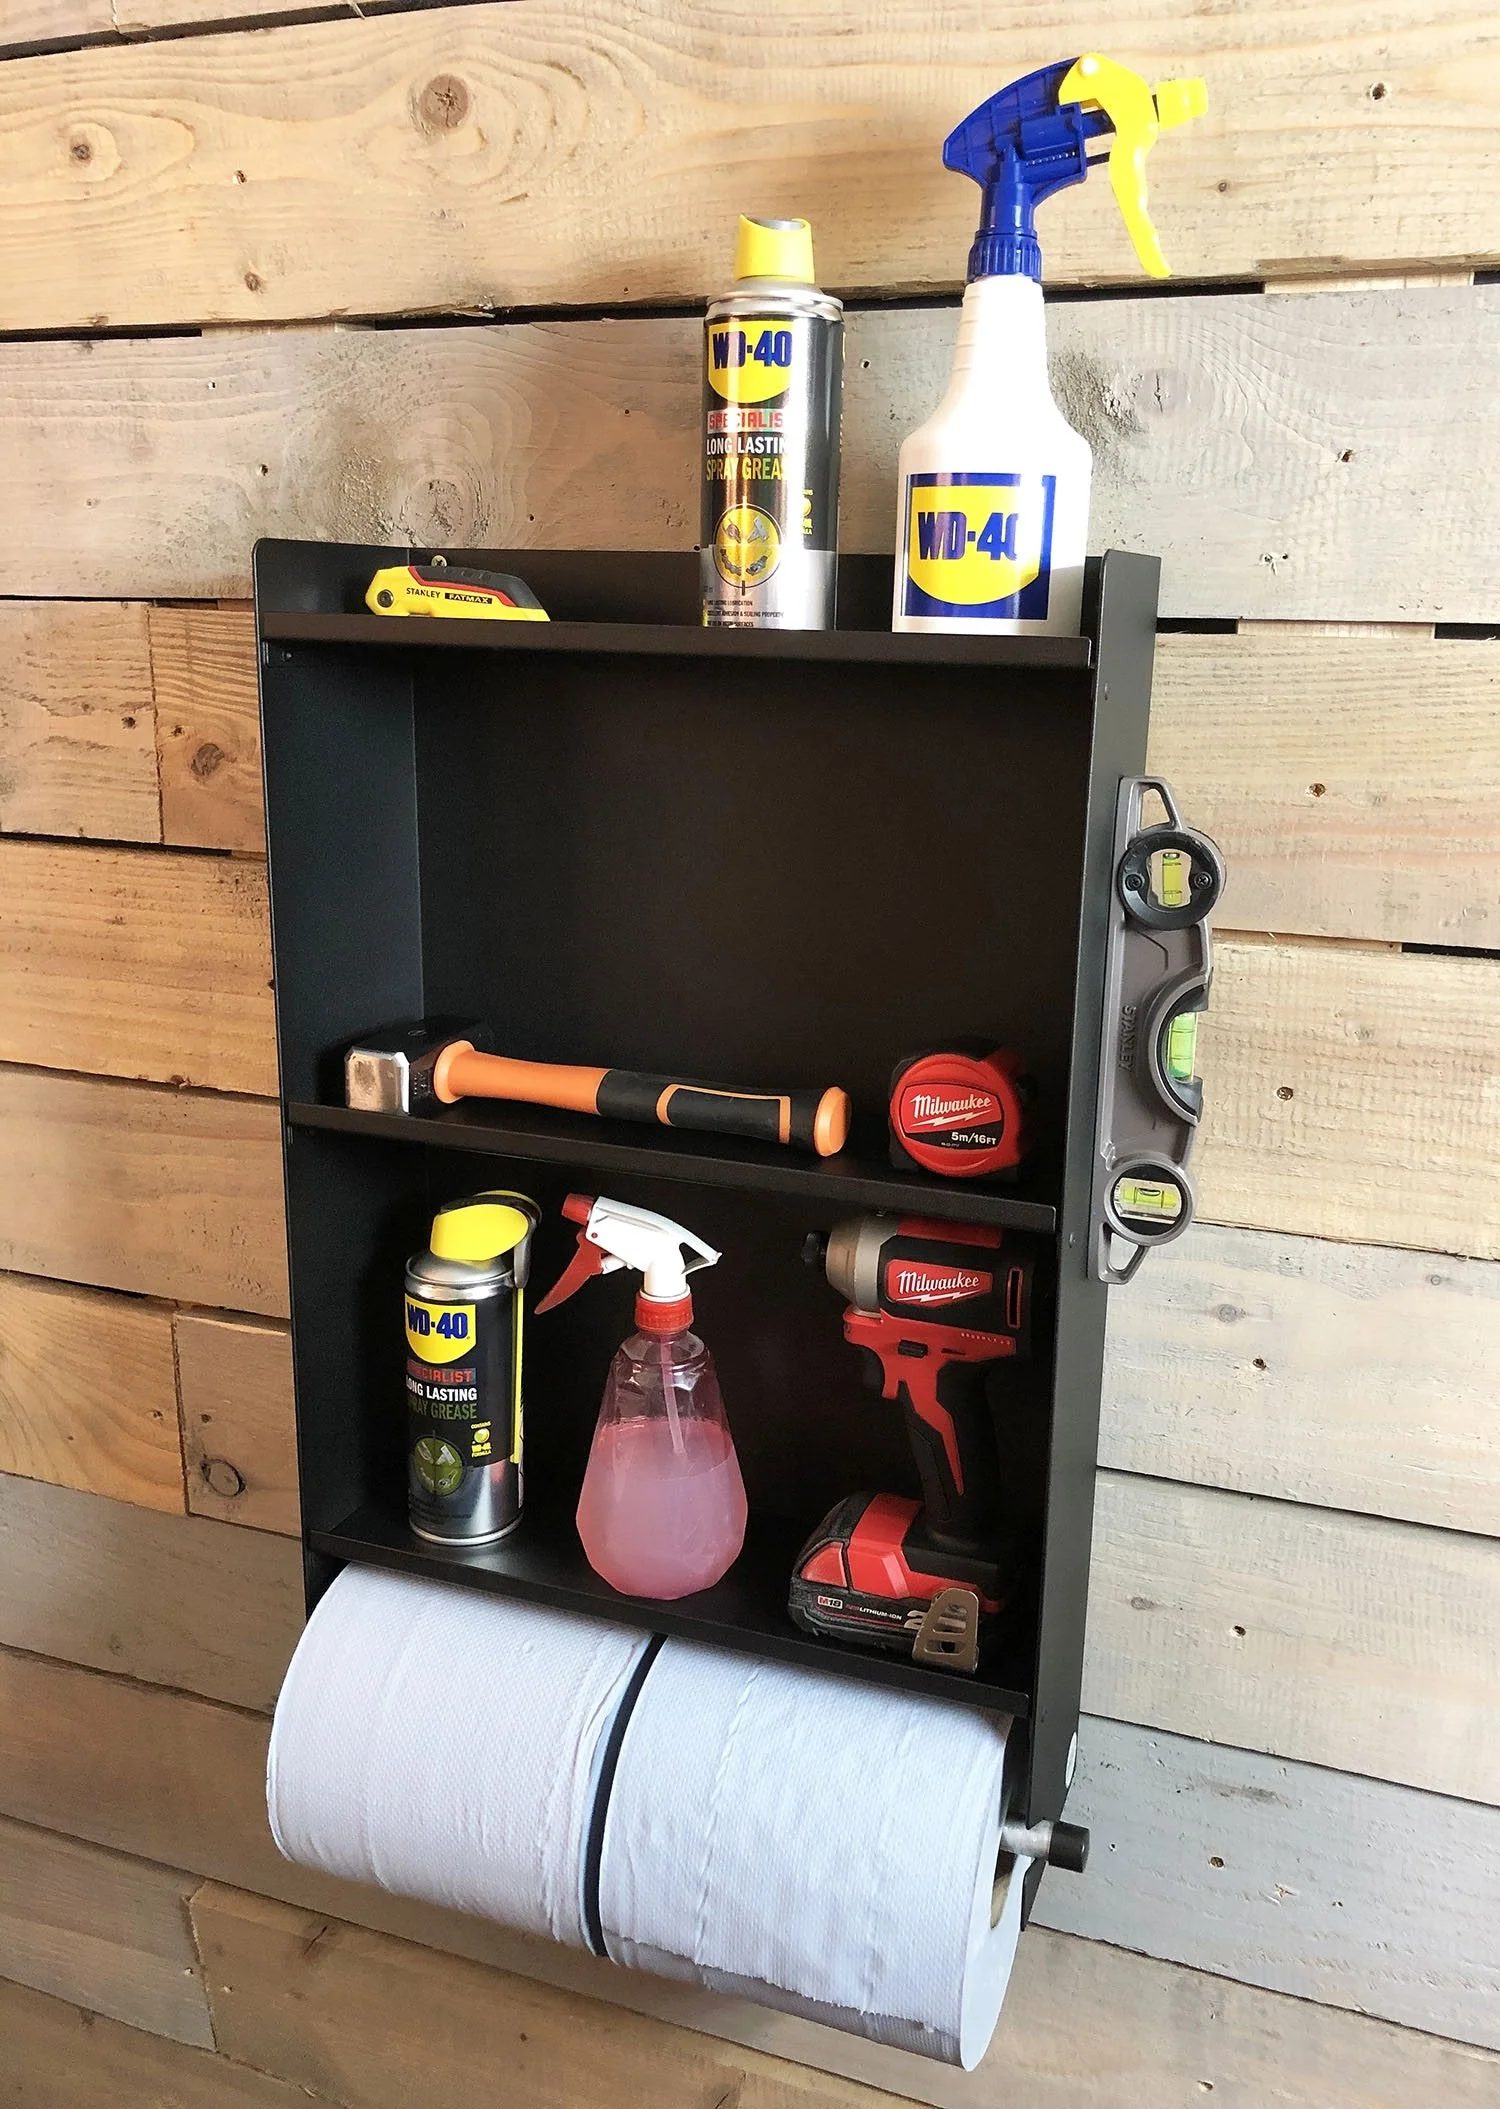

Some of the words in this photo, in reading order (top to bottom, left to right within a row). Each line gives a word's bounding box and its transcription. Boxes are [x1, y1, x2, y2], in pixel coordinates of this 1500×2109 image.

[712, 330, 793, 369] WD-40
[709, 411, 784, 430] SPEIALIS
[706, 437, 733, 455] LONG
[706, 457, 739, 480] SPRAY
[742, 456, 783, 480] GREA
[917, 511, 1019, 560] WD-40
[406, 587, 441, 599] STANLEY
[448, 593, 490, 604] FATMAX
[1119, 1005, 1136, 1072] STANLEY
[910, 1094, 992, 1118] Milwaukee
[951, 1131, 996, 1145] 5m/16FT
[896, 1270, 980, 1294] Milwaukee
[407, 1303, 468, 1339] WD-40
[408, 1362, 472, 1383] CIALIST
[426, 1386, 477, 1401] LASTING
[430, 1402, 477, 1420] GREASE
[819, 1596, 842, 1608] M18
